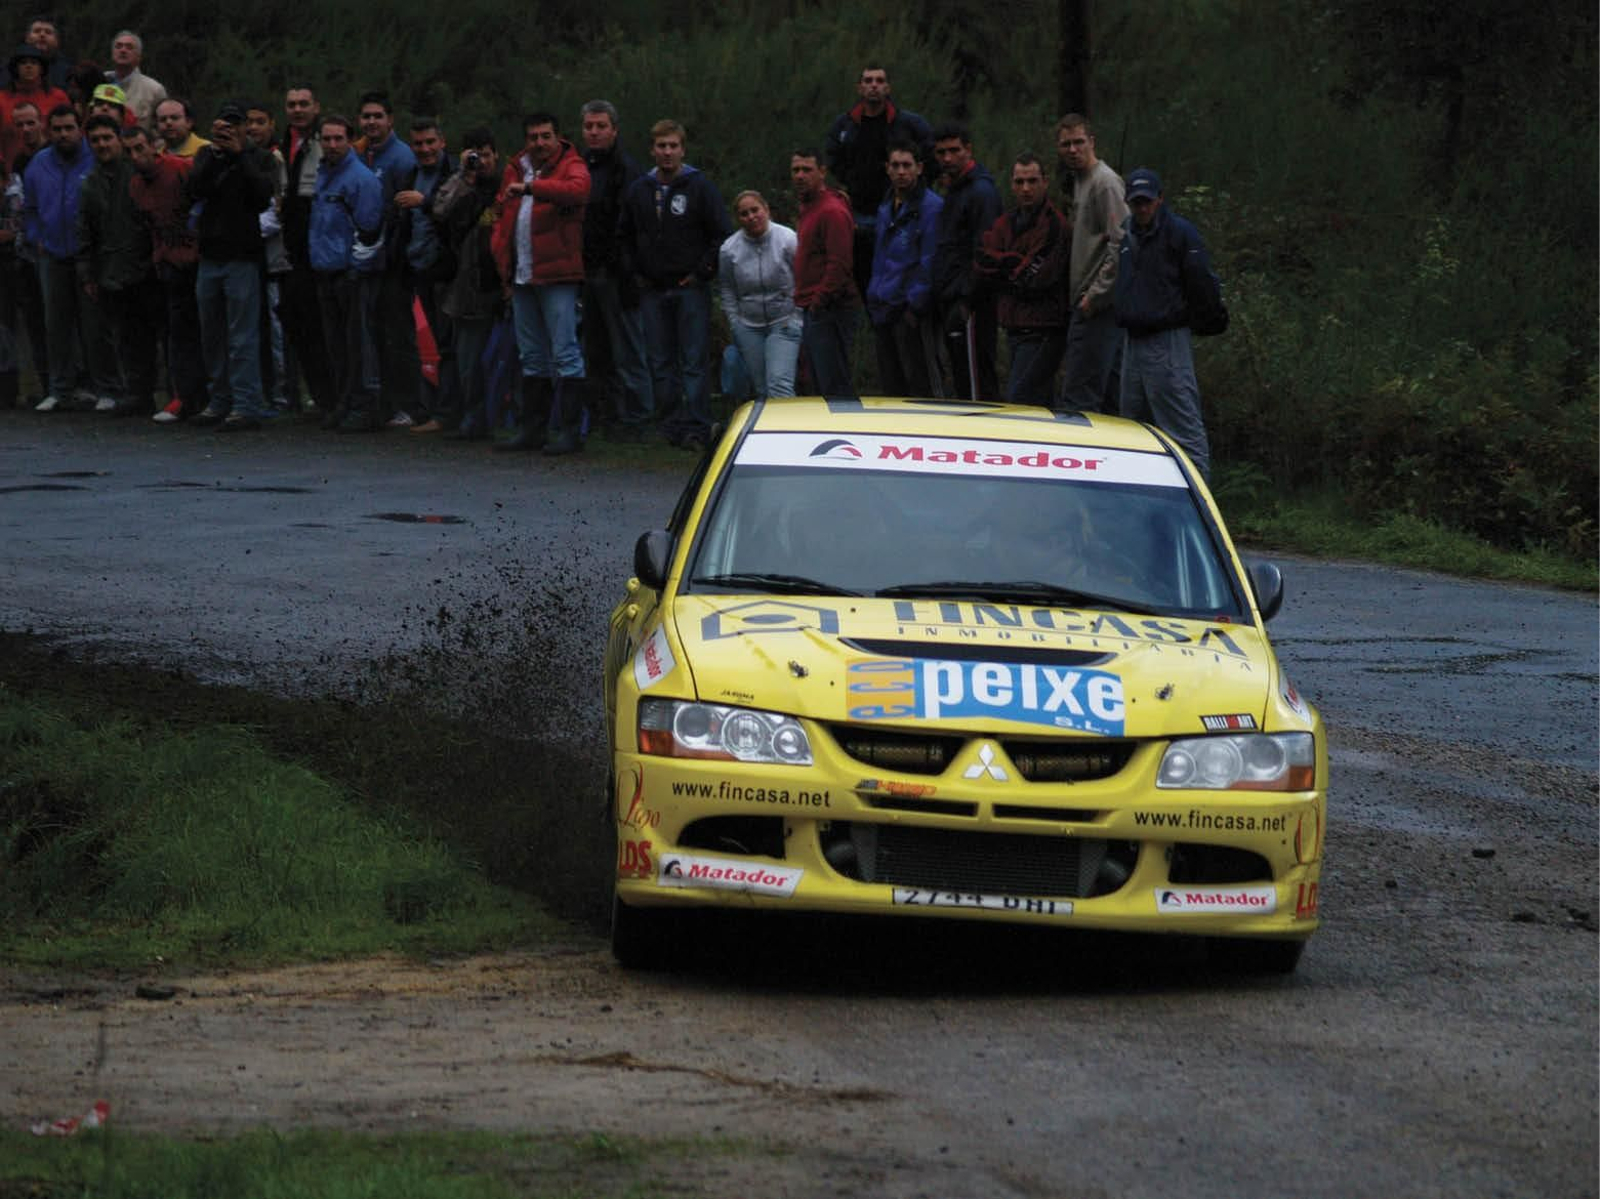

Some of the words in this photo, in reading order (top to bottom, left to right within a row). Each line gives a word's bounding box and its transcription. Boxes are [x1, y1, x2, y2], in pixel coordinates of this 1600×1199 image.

[877, 445, 1104, 470] Matador
[892, 600, 1250, 657] FINCASA
[671, 781, 831, 808] www.fincasa.net
[1134, 810, 1286, 832] www.fincasa.net
[688, 863, 789, 887] Matador
[1185, 892, 1269, 906] Matador
